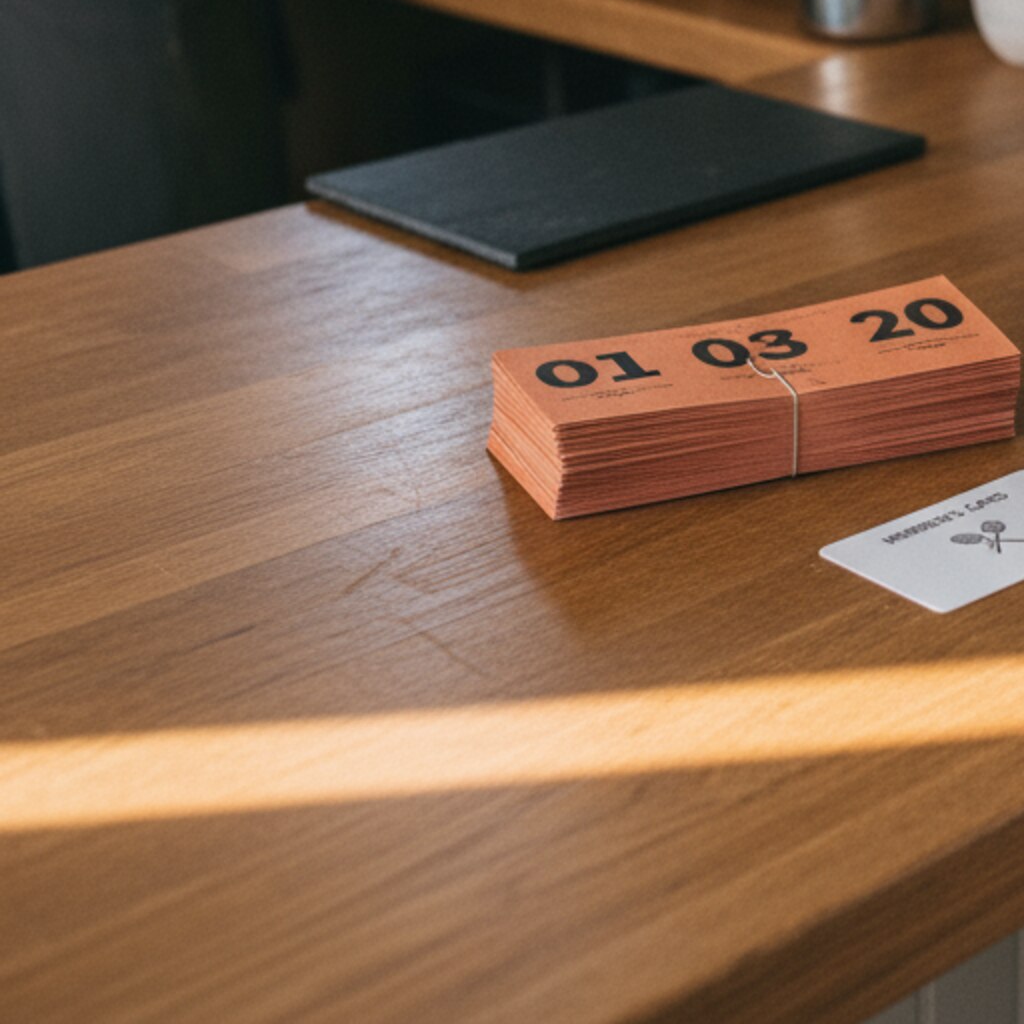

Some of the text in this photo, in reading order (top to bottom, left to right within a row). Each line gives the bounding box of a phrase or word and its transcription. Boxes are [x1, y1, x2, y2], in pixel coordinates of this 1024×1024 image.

[535, 351, 662, 389] 01
[691, 329, 808, 369] 03
[849, 297, 964, 343] 20
